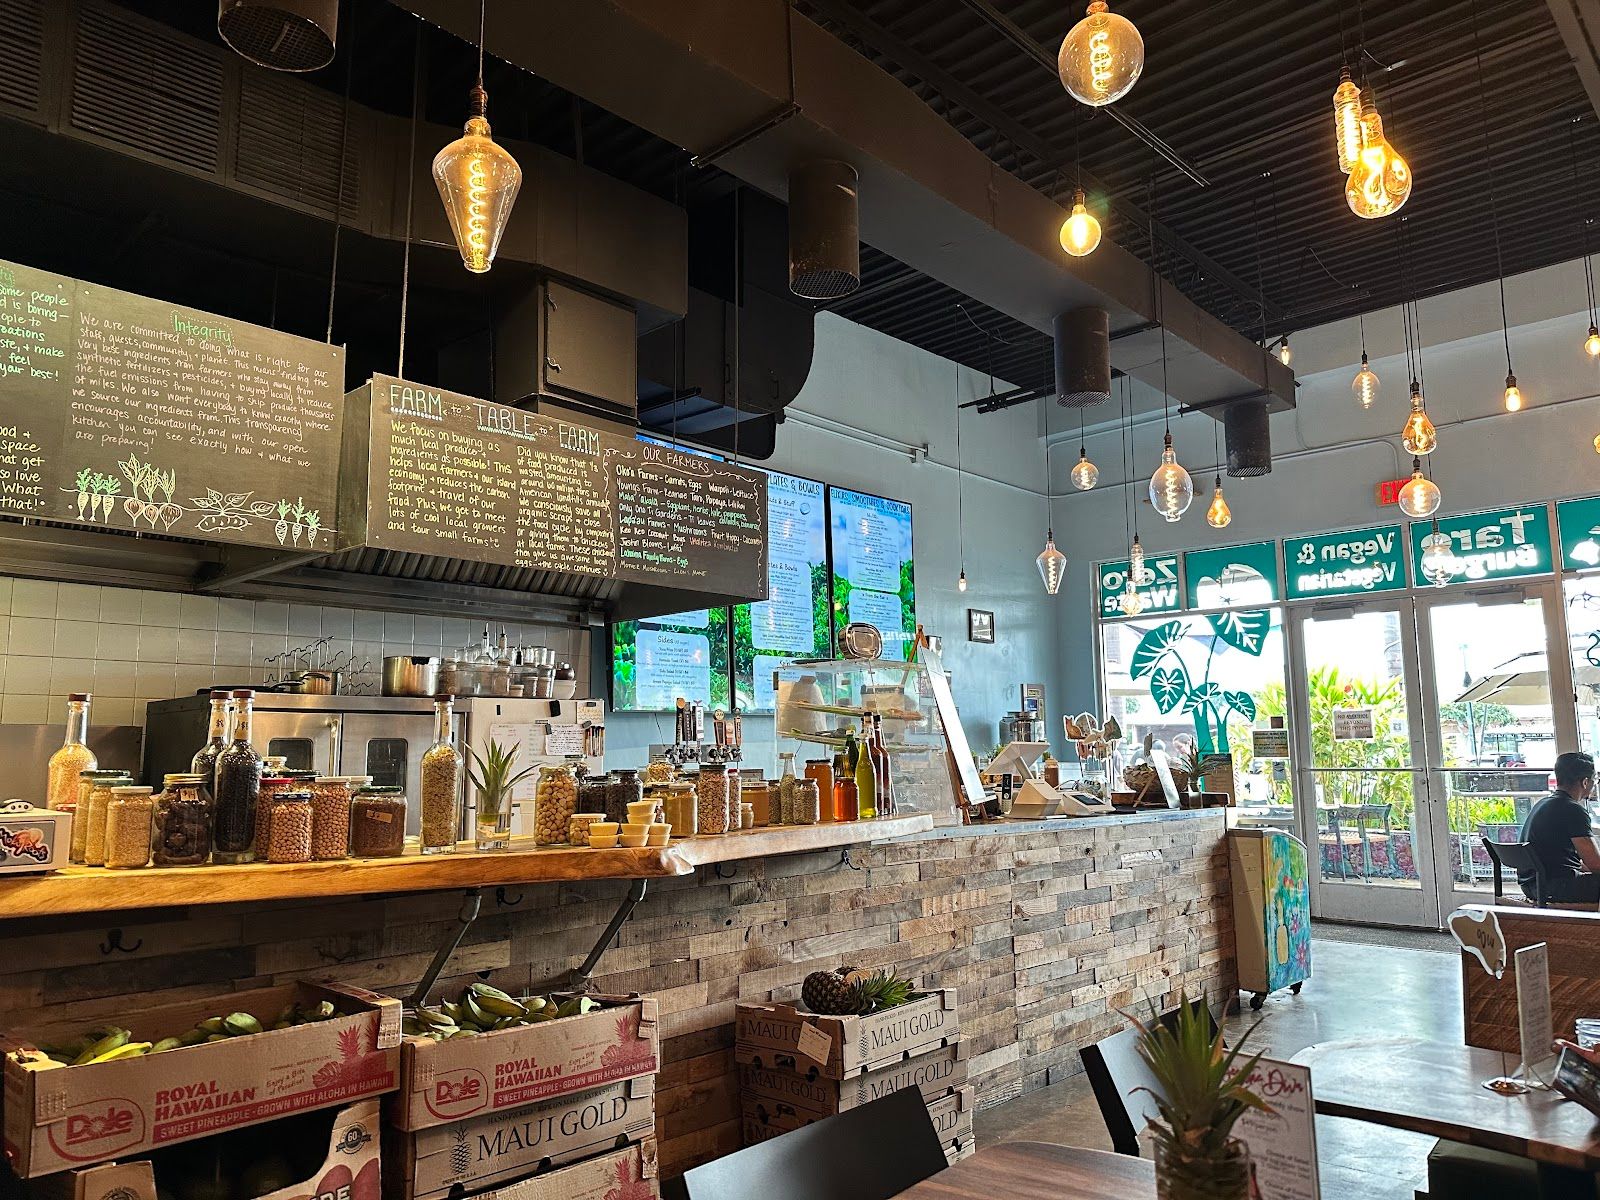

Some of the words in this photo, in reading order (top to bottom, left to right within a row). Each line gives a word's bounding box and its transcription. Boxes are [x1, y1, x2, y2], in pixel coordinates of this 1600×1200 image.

[31, 291, 69, 306] people
[29, 316, 41, 326] to
[174, 315, 231, 346] Integrity
[34, 344, 65, 357] make
[80, 312, 99, 325] We
[103, 319, 125, 331] are
[130, 325, 180, 344] committed
[186, 338, 195, 346] to
[199, 339, 221, 357] doing
[227, 345, 249, 358] what
[266, 357, 291, 372] right
[299, 363, 310, 373] for
[314, 370, 328, 378] our
[9, 352, 30, 365] feel
[71, 401, 129, 421] encourages
[208, 427, 225, 437] and
[232, 432, 254, 443] with
[262, 438, 279, 447] our
[283, 443, 308, 453] open
[390, 385, 441, 416] FARM
[450, 406, 461, 414] to
[473, 403, 535, 436] TABLE
[559, 424, 600, 456] FARM
[72, 415, 111, 428] kitchen
[119, 423, 137, 437] you
[142, 427, 158, 436] can
[165, 432, 183, 441] see
[190, 436, 228, 454] exactly
[235, 444, 252, 454] how
[269, 453, 292, 464] what
[298, 459, 311, 467] we
[76, 431, 94, 440] are
[391, 420, 407, 433] We
[410, 422, 435, 438] focus
[438, 430, 449, 440] on
[452, 432, 483, 452] buying
[488, 442, 500, 452] as
[391, 434, 415, 446] much
[421, 438, 439, 450] local
[444, 443, 477, 457] produce
[22, 457, 45, 471] get
[391, 445, 438, 461] ingredients
[441, 455, 450, 463] as
[493, 461, 512, 474] This
[517, 446, 531, 457] Did
[535, 450, 548, 461] you
[550, 453, 568, 464] know
[570, 457, 586, 468] that
[642, 447, 662, 462] OUR
[667, 453, 709, 473] FARMERS
[15, 470, 41, 482] love
[390, 456, 413, 468] helps
[418, 459, 437, 472] local
[440, 464, 472, 478] farmers
[482, 474, 494, 484] our
[497, 476, 516, 489] island
[769, 474, 788, 488] LATES
[2, 481, 43, 496] What
[0, 496, 38, 511] that!
[439, 502, 452, 511] we
[456, 503, 469, 518] get
[472, 508, 481, 517] to
[485, 513, 506, 523] meet
[387, 521, 405, 531] and
[411, 524, 430, 535] tour
[435, 529, 457, 539] small
[389, 506, 404, 518] lots
[410, 509, 419, 520] of
[424, 512, 439, 523] cool
[445, 516, 468, 528] local
[473, 523, 506, 534] growers
[657, 635, 674, 645] Sides
[749, 1020, 789, 1040] MAUI
[871, 1018, 907, 1049] MAUI
[909, 1009, 944, 1034] GOLD
[495, 1057, 538, 1076] ROYAL
[495, 1064, 562, 1089] HAWAIIAN
[436, 1076, 480, 1101] Dole
[498, 1092, 521, 1104] SWEET
[522, 1083, 558, 1098] PINEAPPLE
[563, 1078, 586, 1088] GROWN
[587, 1073, 602, 1083] WITH
[752, 1073, 790, 1092] MAUI
[792, 1080, 826, 1102] GOLD
[870, 1072, 910, 1100] MAUI
[914, 1060, 953, 1085] GOLD
[154, 1088, 256, 1122] HAWAIIAN
[155, 1080, 219, 1106] ROYAL
[160, 1122, 195, 1138] SWEET
[197, 1110, 250, 1129] PINEAPPLE
[257, 1101, 291, 1115] GROWN
[293, 1096, 316, 1108] WITH
[317, 1089, 346, 1103] ALOHA
[349, 1086, 358, 1096] IN
[359, 1078, 389, 1093] HAWAII
[66, 1107, 133, 1140] Dole
[476, 1116, 555, 1161] MAUI
[560, 1096, 628, 1136] GOLD
[933, 1110, 958, 1134] OLD
[348, 1131, 357, 1141] 60
